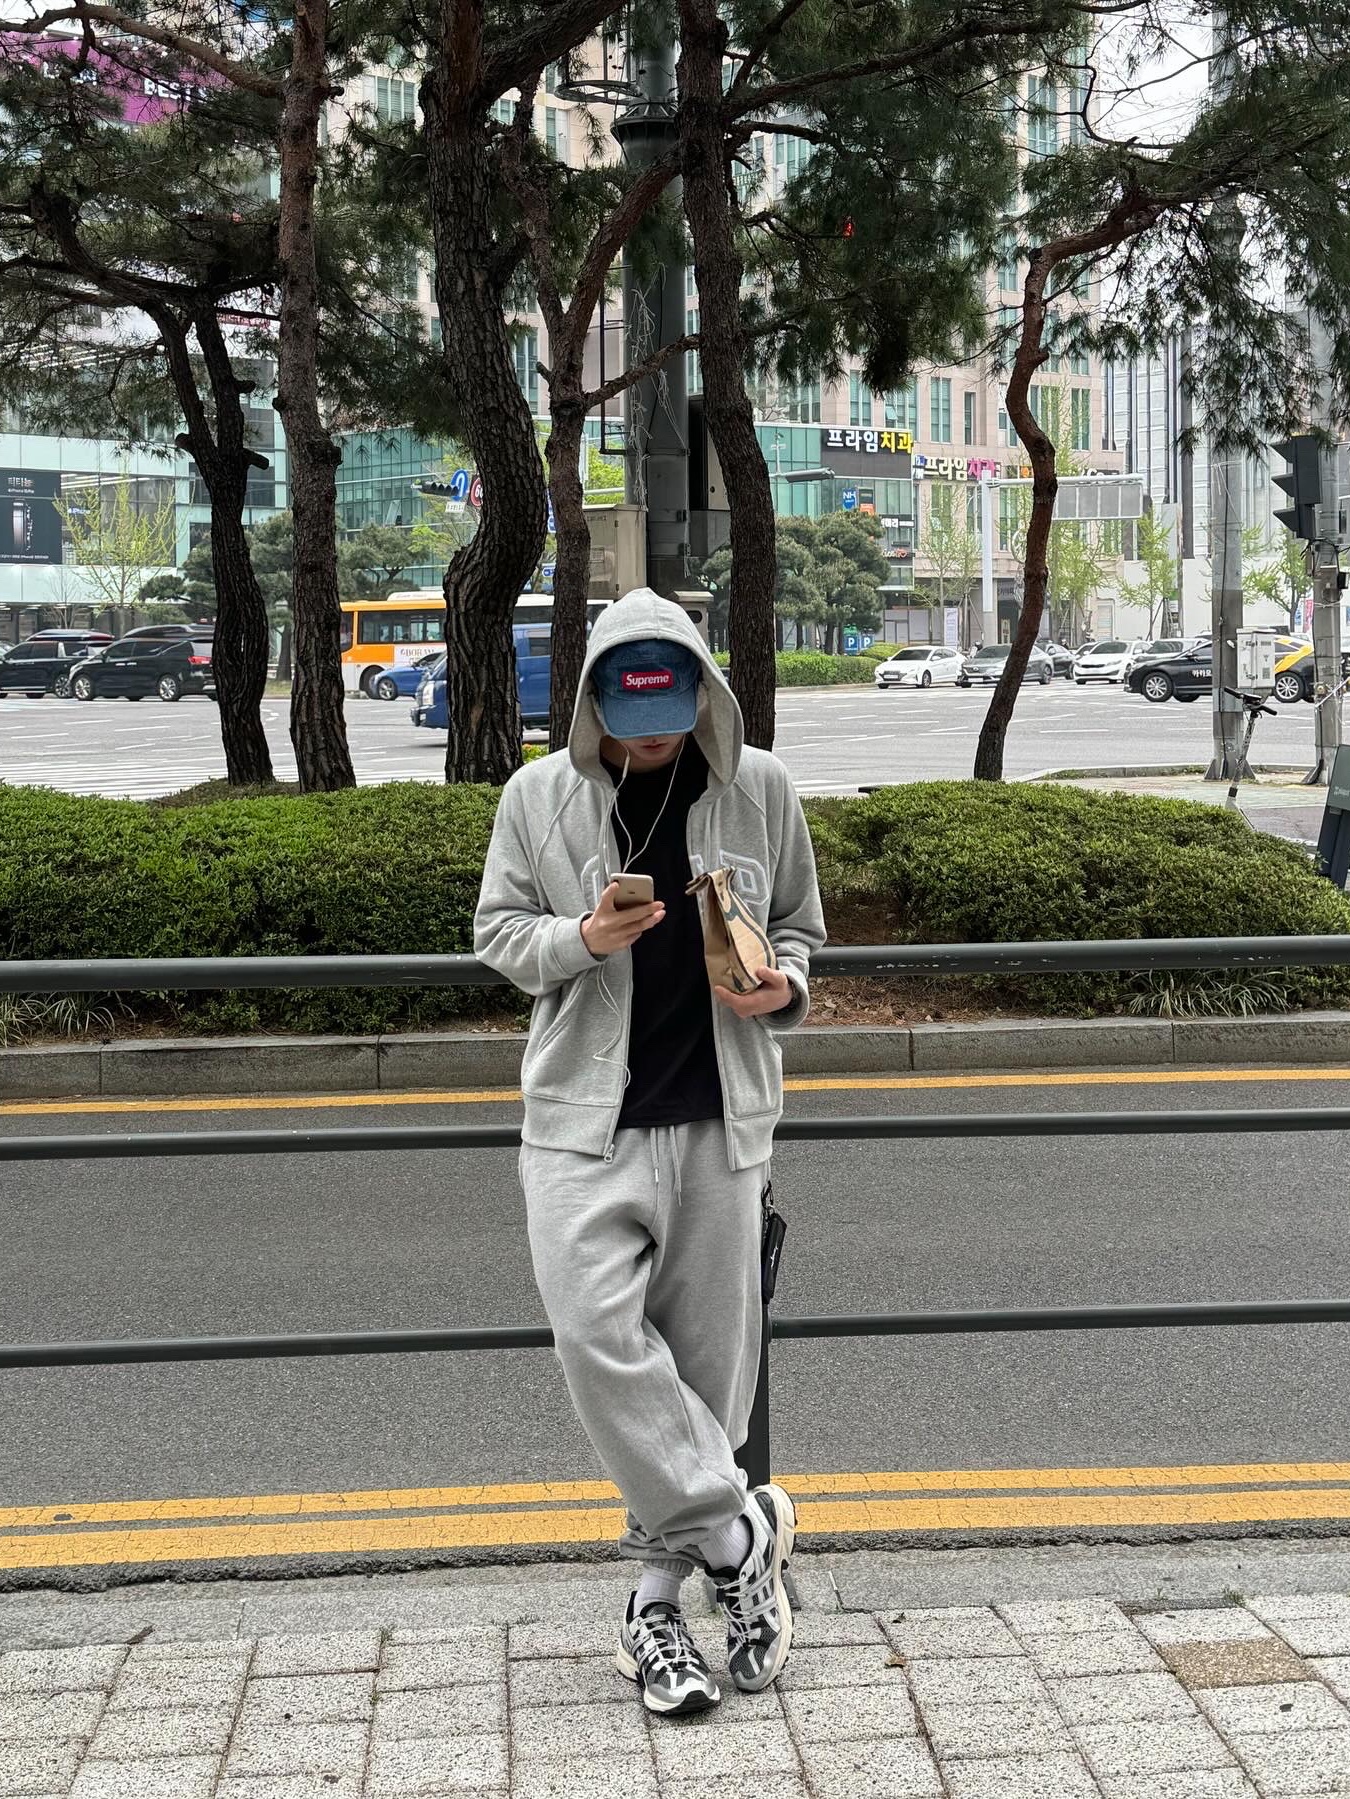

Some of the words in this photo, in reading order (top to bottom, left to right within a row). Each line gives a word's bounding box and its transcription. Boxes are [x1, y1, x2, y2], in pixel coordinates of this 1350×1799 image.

[827, 430, 913, 453] 프라임치과
[843, 491, 856, 500] NH
[848, 637, 855, 648] P
[863, 637, 871, 648] P
[625, 674, 669, 688] Supreme
